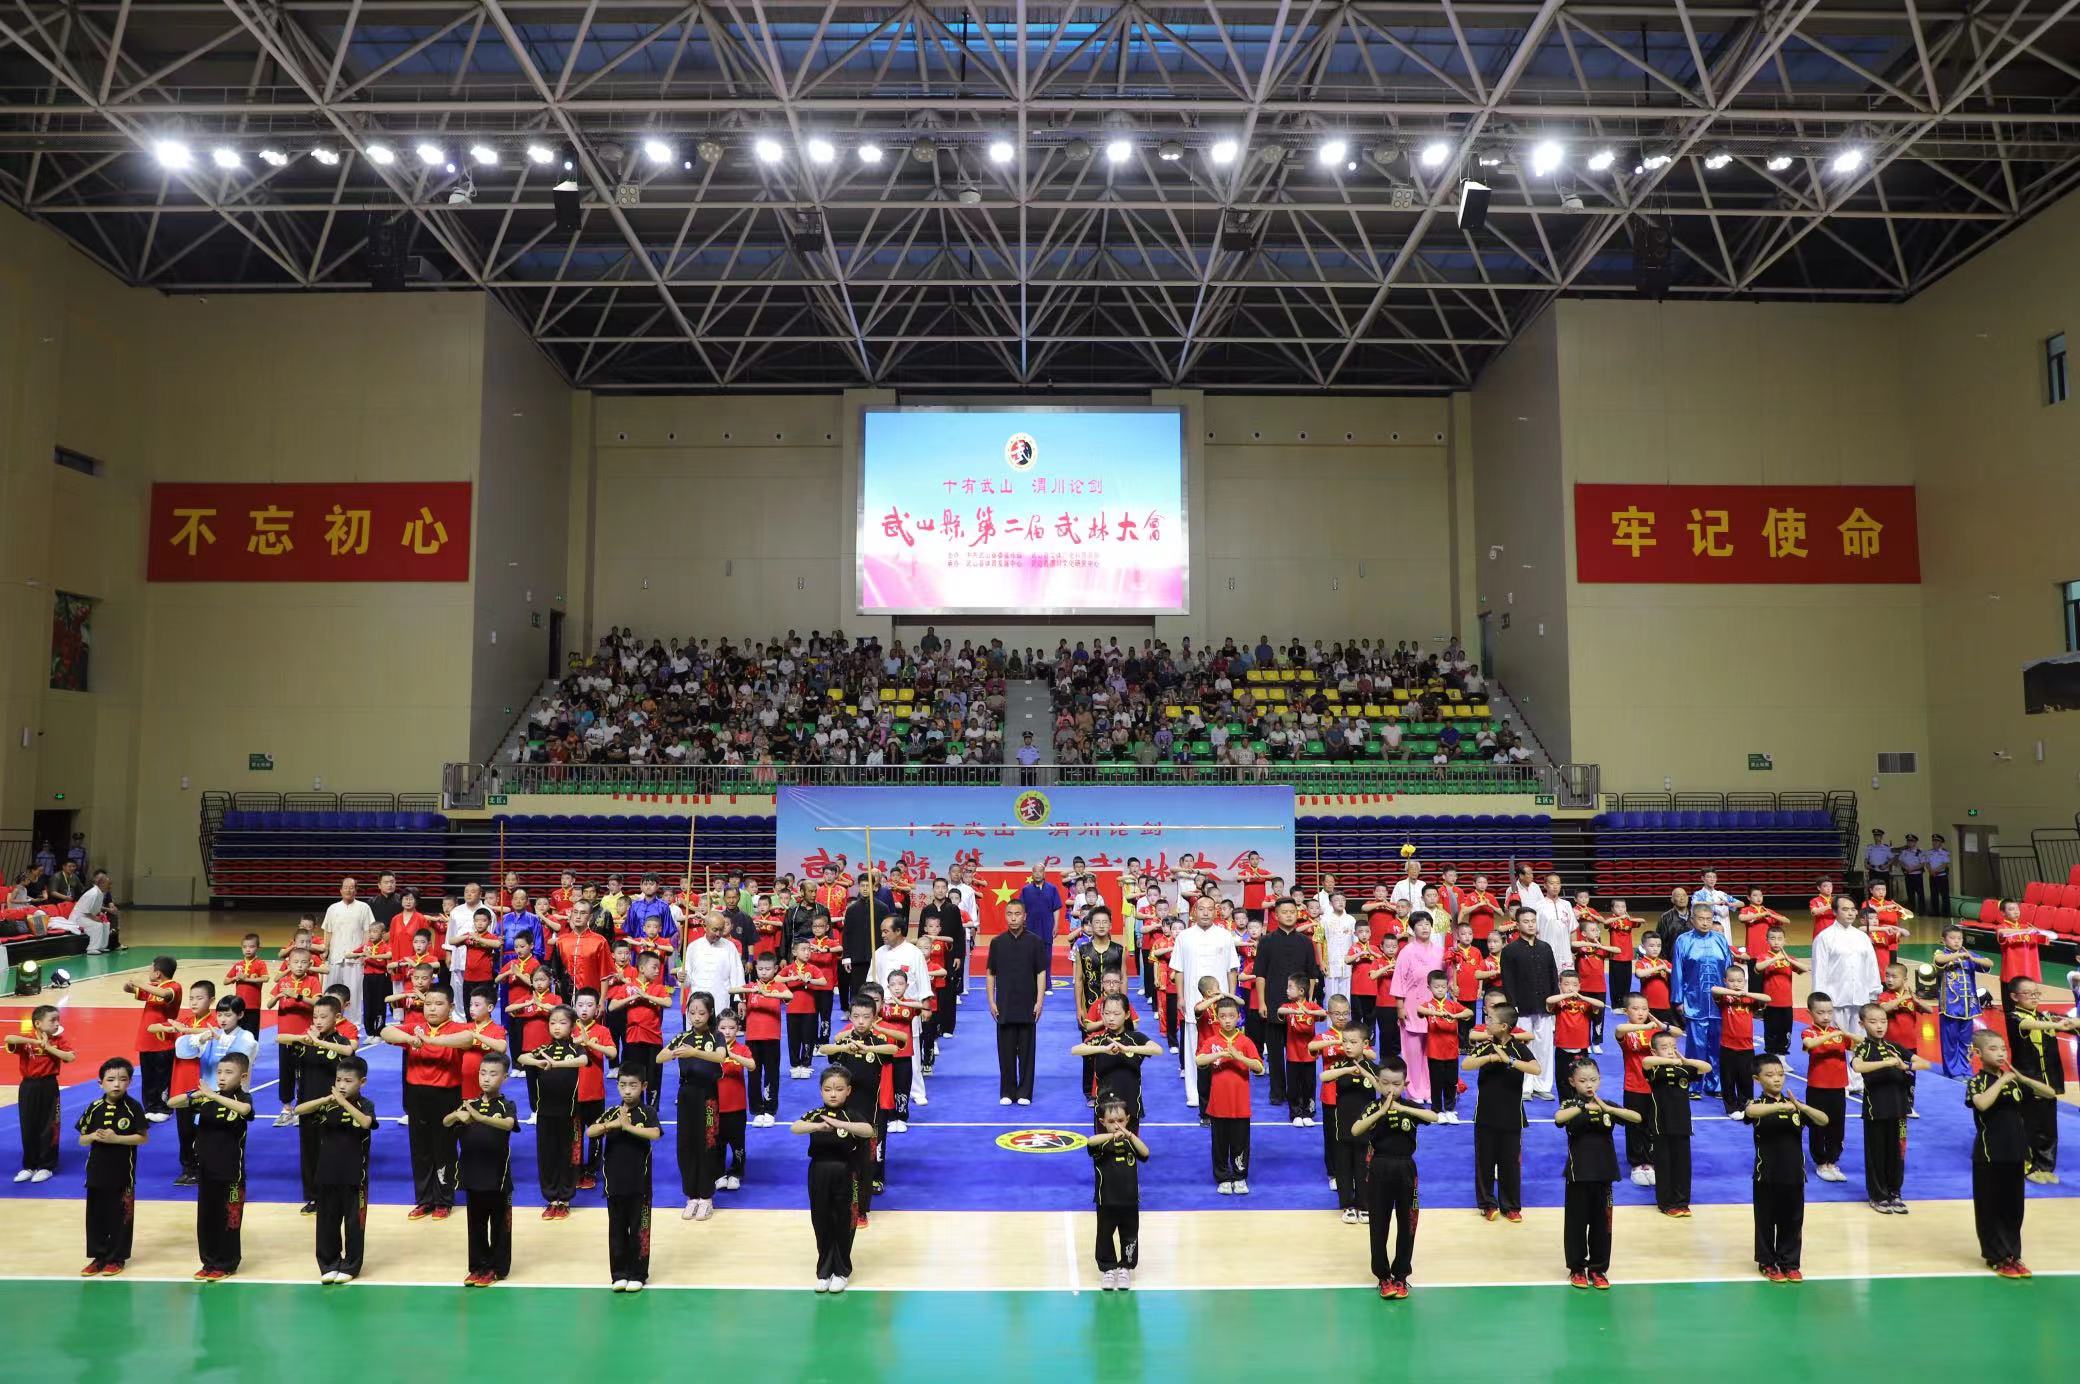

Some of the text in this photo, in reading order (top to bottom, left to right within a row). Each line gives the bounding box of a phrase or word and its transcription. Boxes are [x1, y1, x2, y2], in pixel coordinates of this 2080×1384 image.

[1031, 477, 1104, 495] 渭川论剑
[169, 503, 449, 557] 不忘初心
[1611, 505, 1884, 559] 牢记使命
